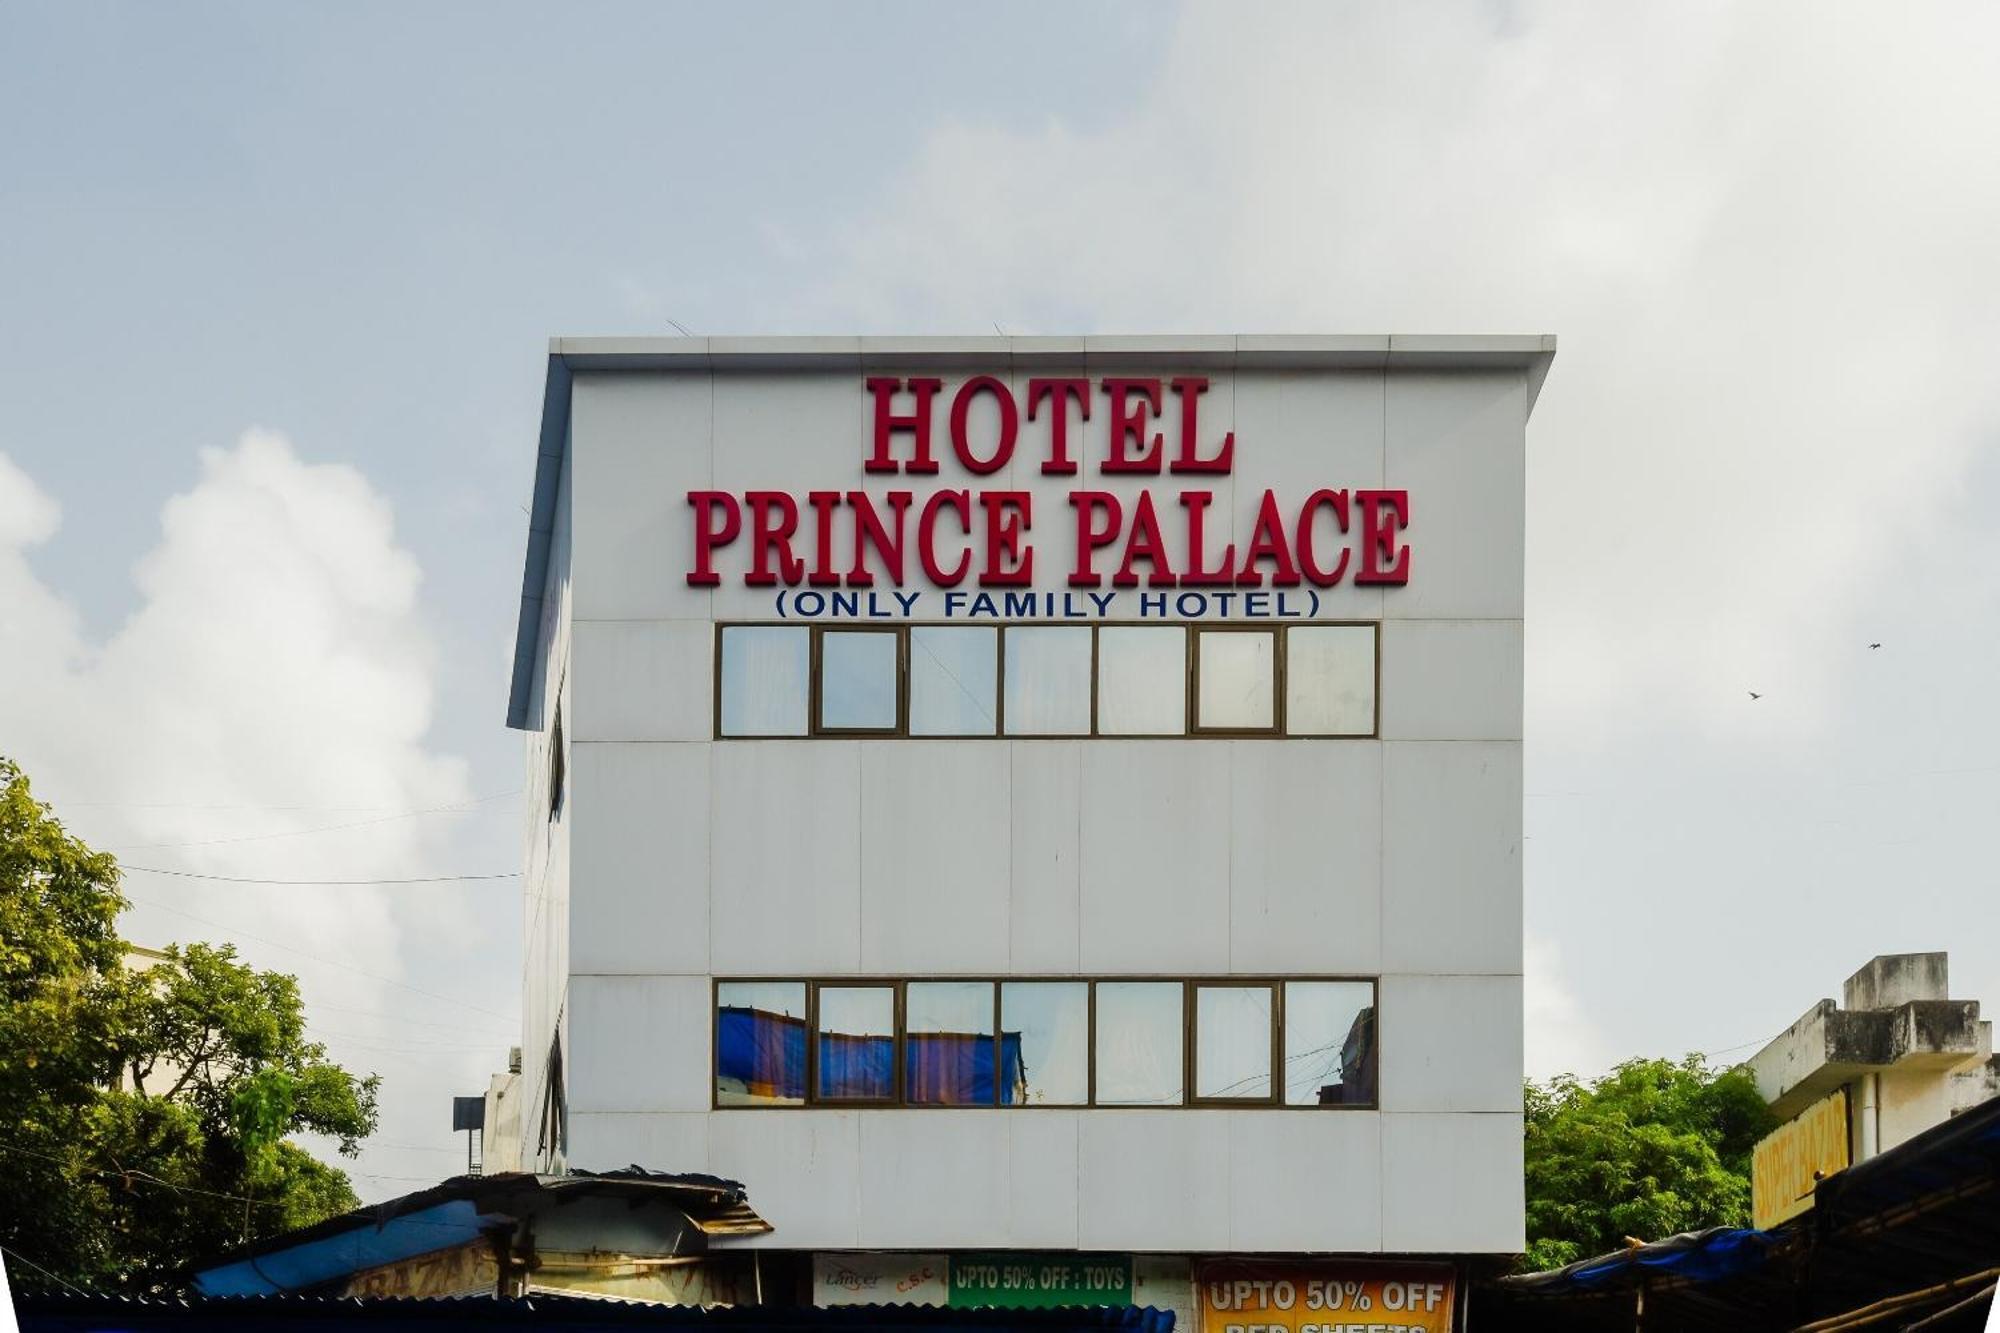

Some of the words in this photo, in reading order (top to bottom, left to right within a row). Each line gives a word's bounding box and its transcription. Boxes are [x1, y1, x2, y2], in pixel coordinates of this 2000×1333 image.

[864, 375, 1235, 476] HOTEL
[687, 489, 1035, 588] PRINCE
[1068, 489, 1411, 588] PALACE
[776, 591, 920, 618] (ONLY
[945, 591, 1115, 618] FAMILY
[1141, 591, 1320, 618] HOTEL)
[957, 1265, 999, 1289] UPTO
[1003, 1265, 1036, 1290] 50%
[1040, 1266, 1071, 1290] OFF
[1085, 1266, 1125, 1290] TOYS
[1210, 1280, 1297, 1311] UPTO
[1306, 1280, 1372, 1312] 50%
[1382, 1281, 1444, 1312] OFF
